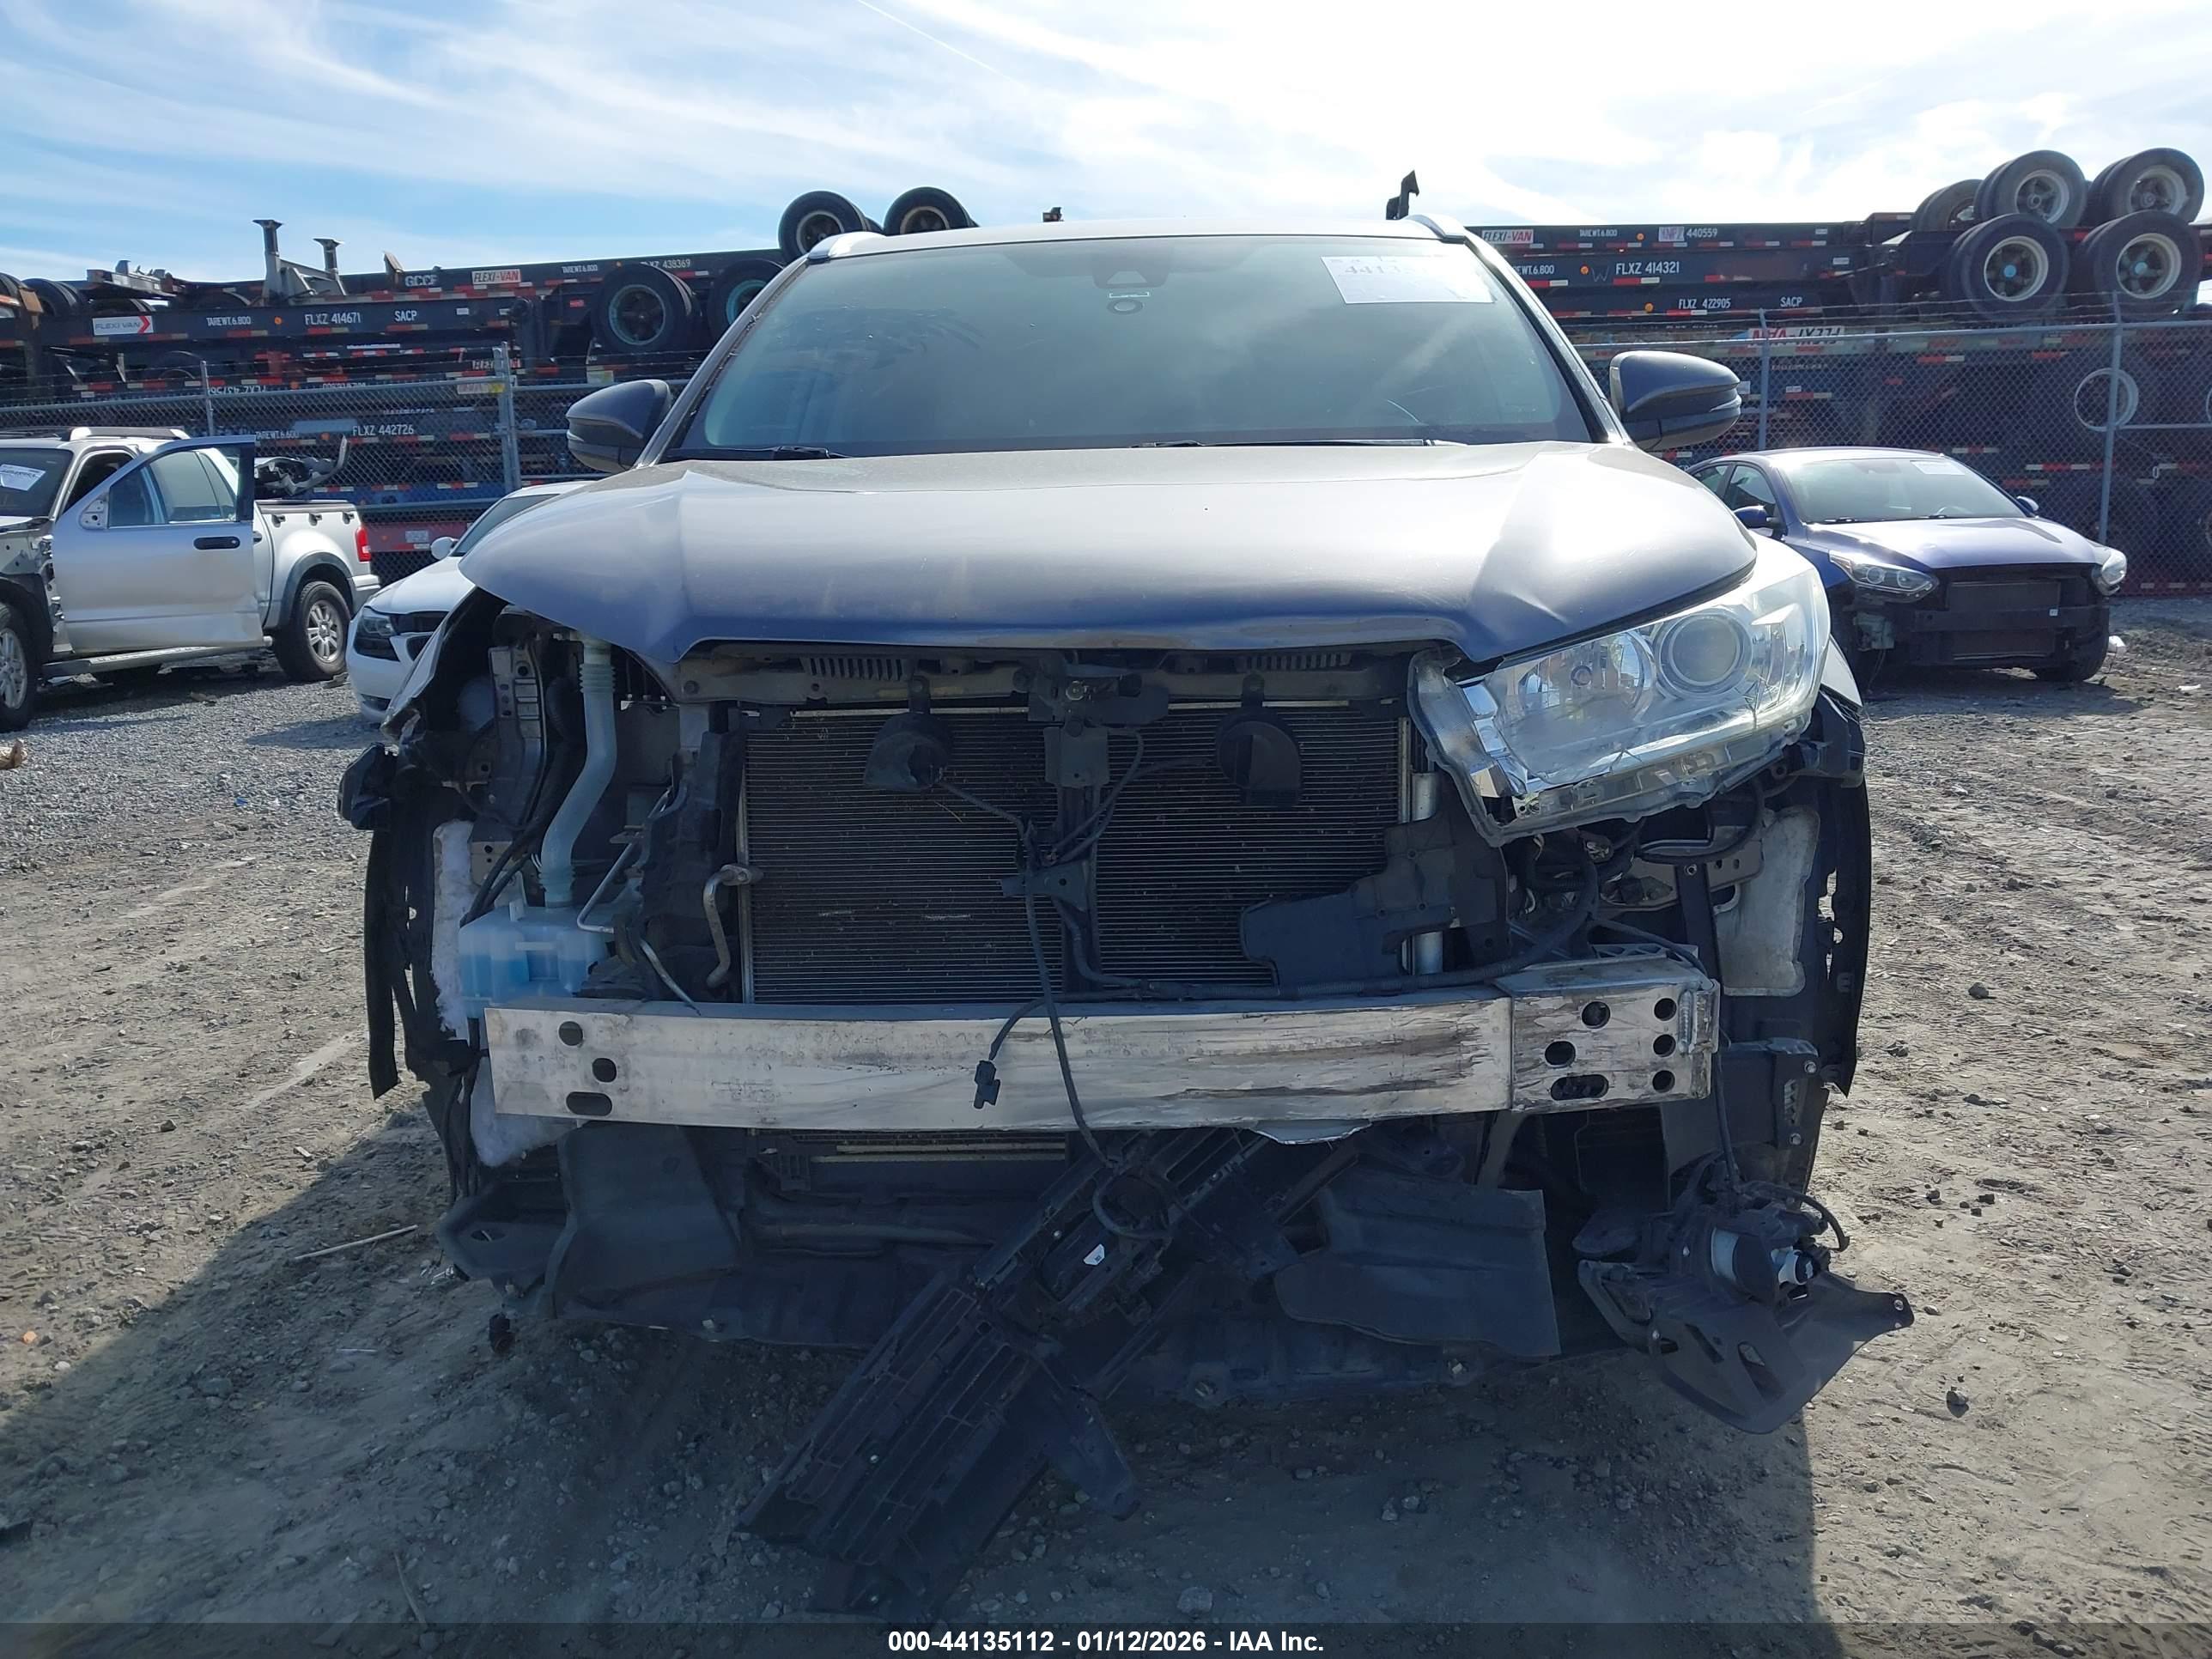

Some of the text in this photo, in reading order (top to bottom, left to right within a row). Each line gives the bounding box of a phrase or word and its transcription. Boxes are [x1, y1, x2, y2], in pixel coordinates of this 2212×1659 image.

[1483, 230, 1533, 242] FLEXI-VAN
[1686, 228, 1717, 238] 440559
[662, 258, 691, 269] 438369
[1615, 261, 1680, 275] FLXZ 414321
[474, 270, 520, 283] FLEXI-VAN
[1678, 297, 1732, 310] FLXZ 422905
[1779, 296, 1803, 307] SACP
[305, 312, 362, 325] FLXZ 414671
[394, 310, 418, 322] SACP
[352, 423, 415, 436] FLXZ 442726
